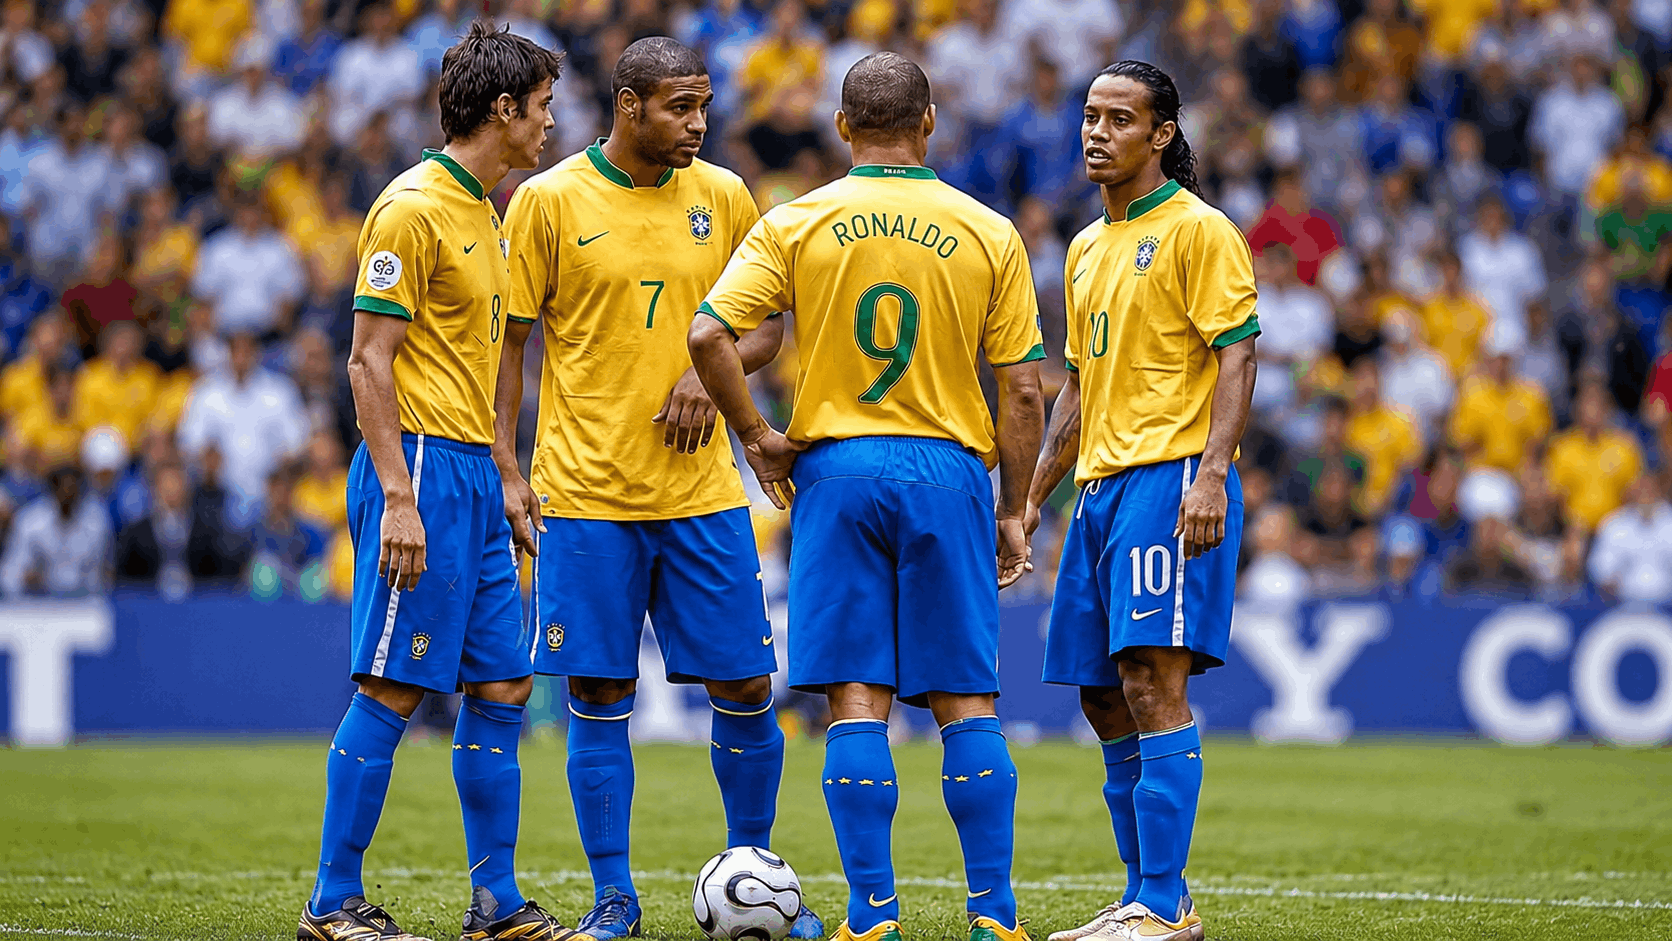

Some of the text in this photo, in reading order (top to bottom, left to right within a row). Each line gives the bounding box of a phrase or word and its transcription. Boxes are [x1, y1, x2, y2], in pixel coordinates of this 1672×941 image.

[831, 212, 959, 259] RONALDO
[490, 294, 501, 343] 8
[639, 280, 665, 329] 7
[853, 281, 921, 405] 9
[1087, 310, 1109, 360] 10
[1129, 544, 1171, 597] 10
